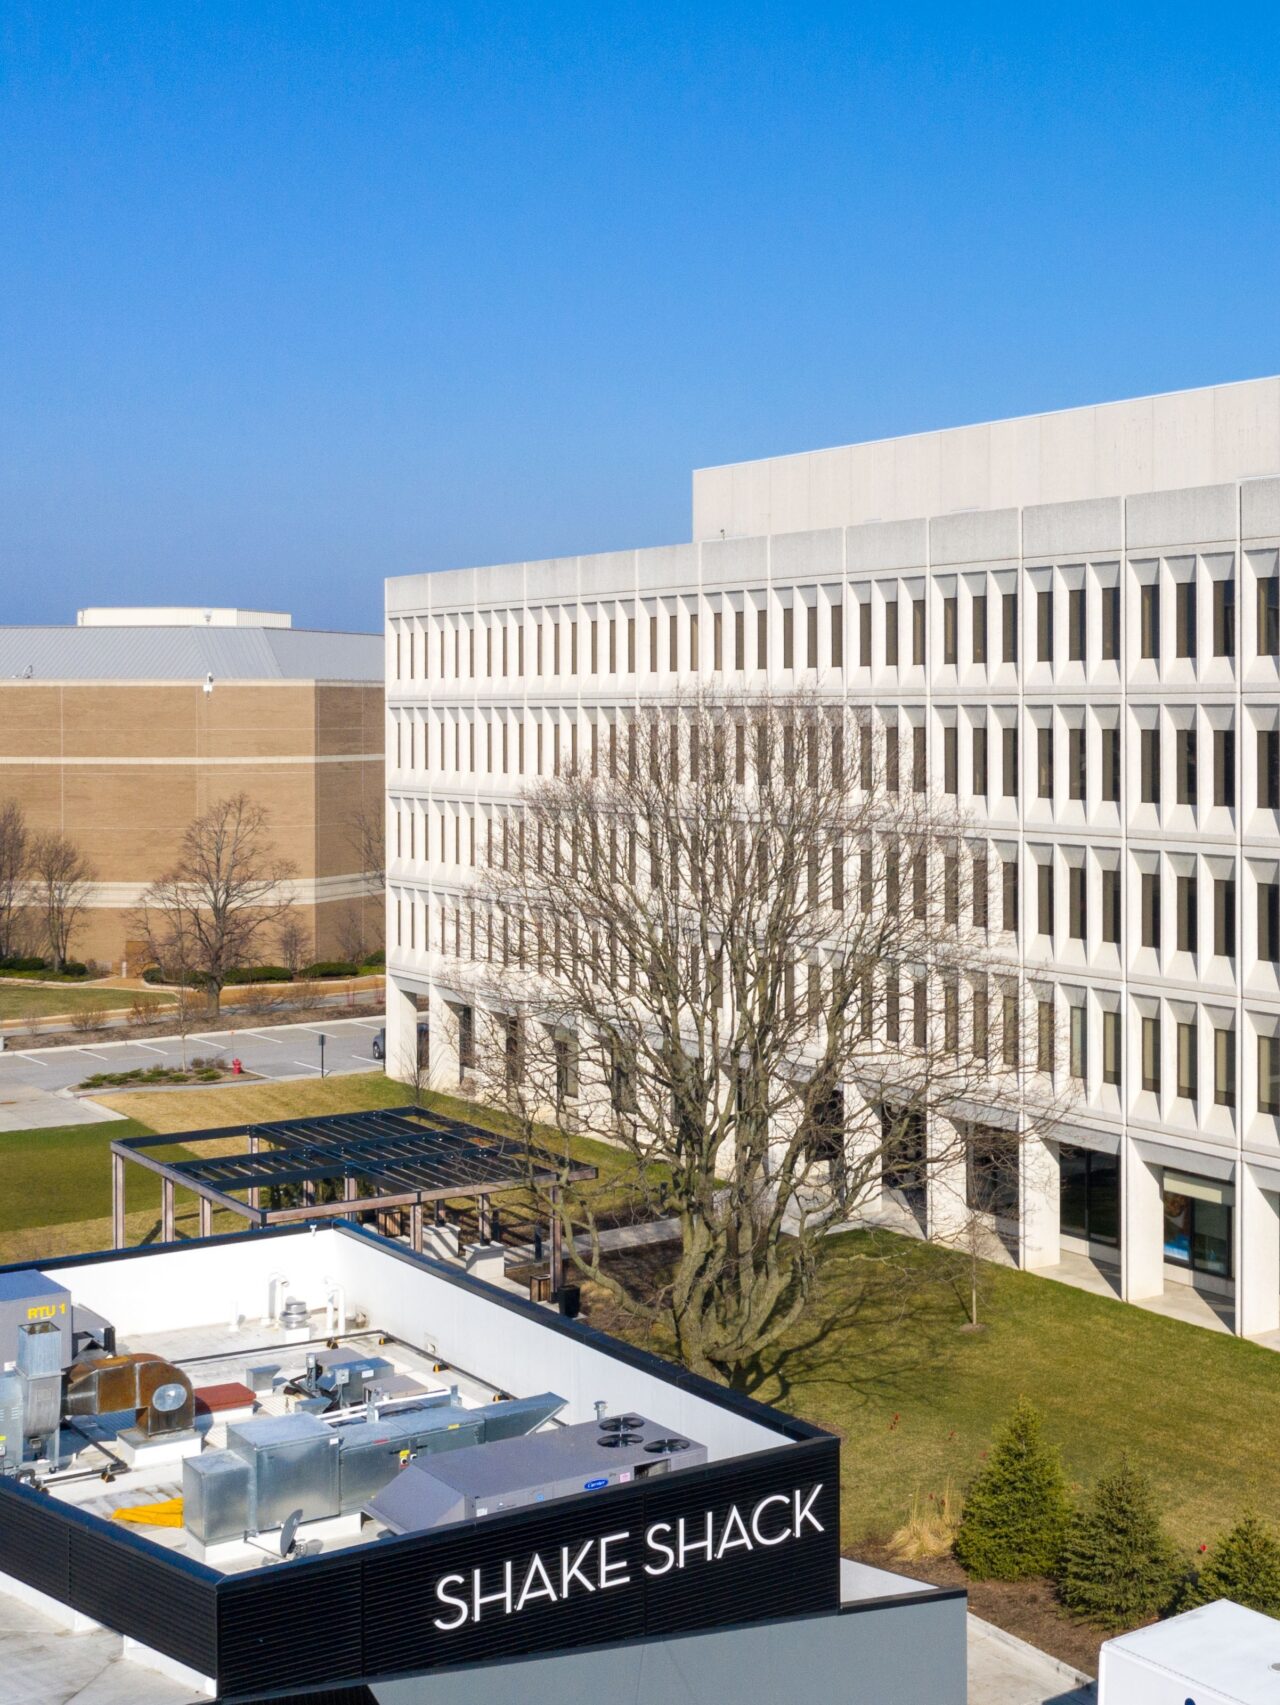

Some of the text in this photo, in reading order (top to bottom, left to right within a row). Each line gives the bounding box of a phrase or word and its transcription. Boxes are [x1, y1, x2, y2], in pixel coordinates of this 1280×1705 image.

[27, 1303, 66, 1320] RTU 1
[433, 1483, 825, 1631] SHAKE SHACK
